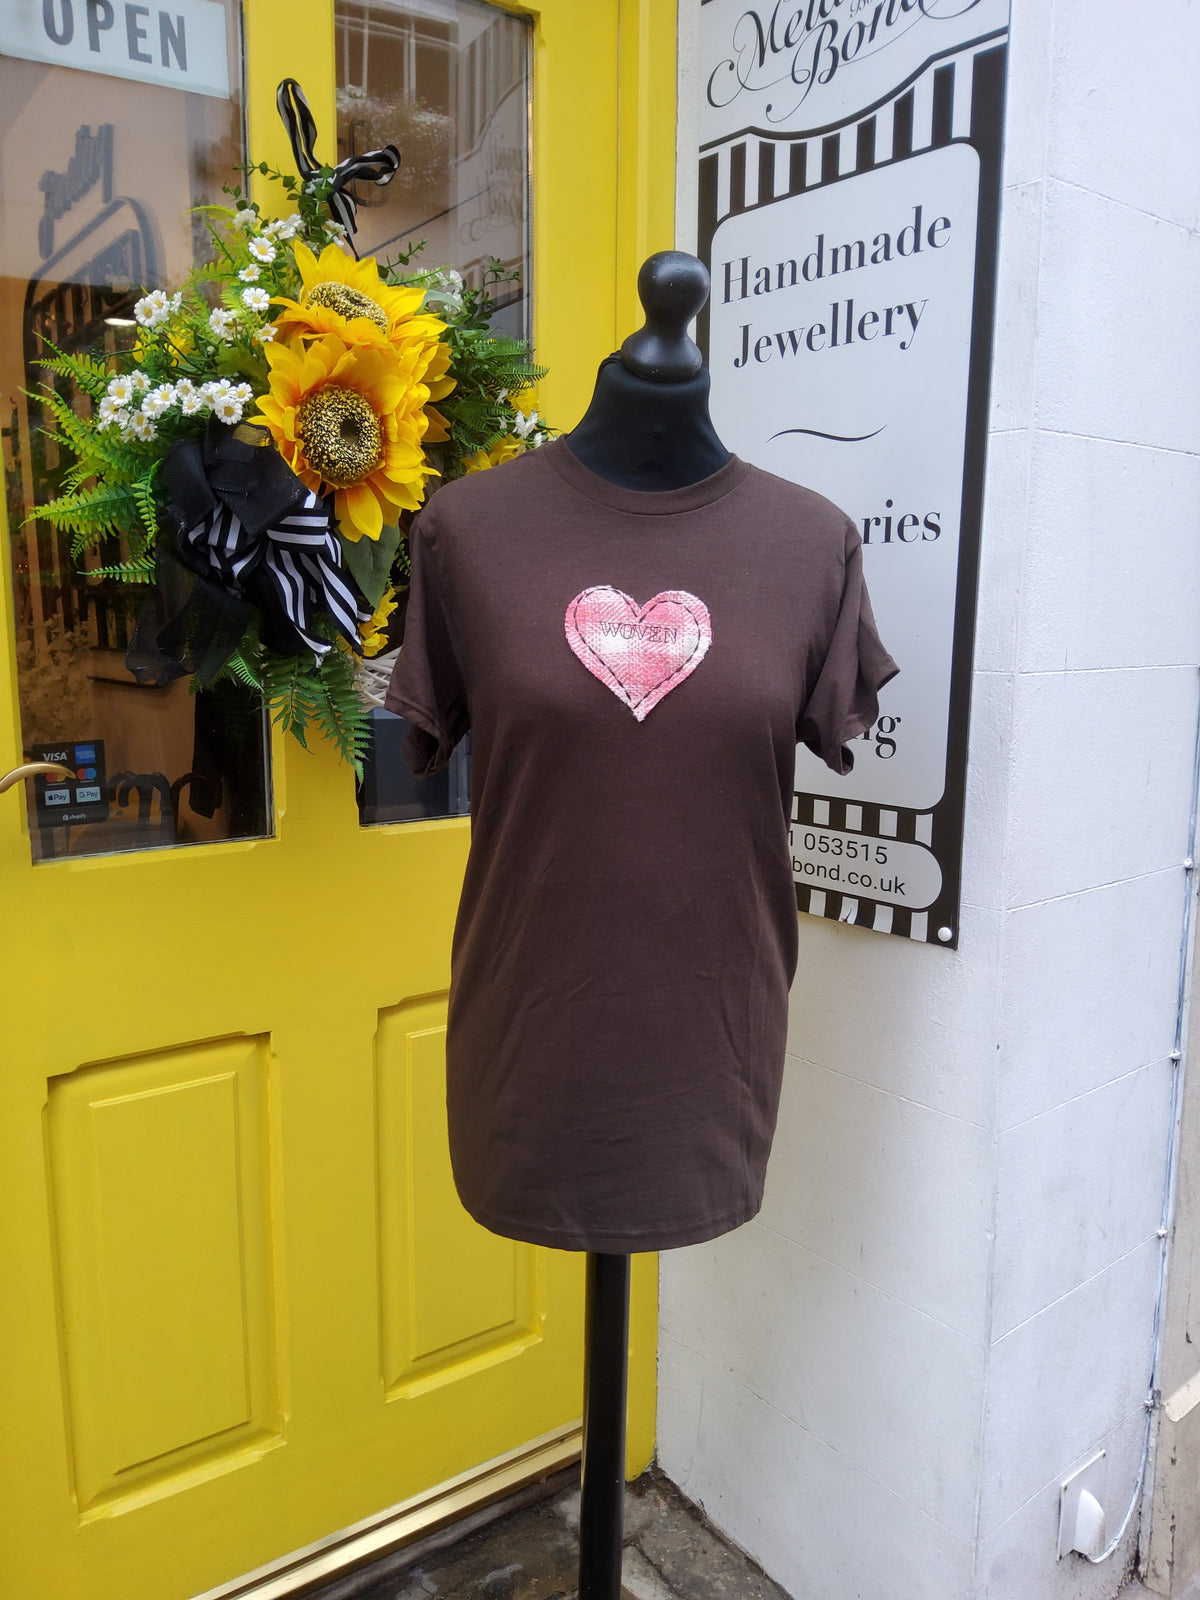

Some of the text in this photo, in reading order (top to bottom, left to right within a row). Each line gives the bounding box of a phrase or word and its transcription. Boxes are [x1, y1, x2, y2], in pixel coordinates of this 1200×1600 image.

[42, 0, 188, 72] OPEN
[720, 204, 951, 305] Handmade
[733, 298, 929, 368] Jewellery
[600, 621, 678, 644] WOVEN
[42, 751, 68, 762] VISA
[53, 793, 67, 801] Pay
[804, 832, 888, 865] 053515
[792, 855, 906, 896] bond.co.uk
